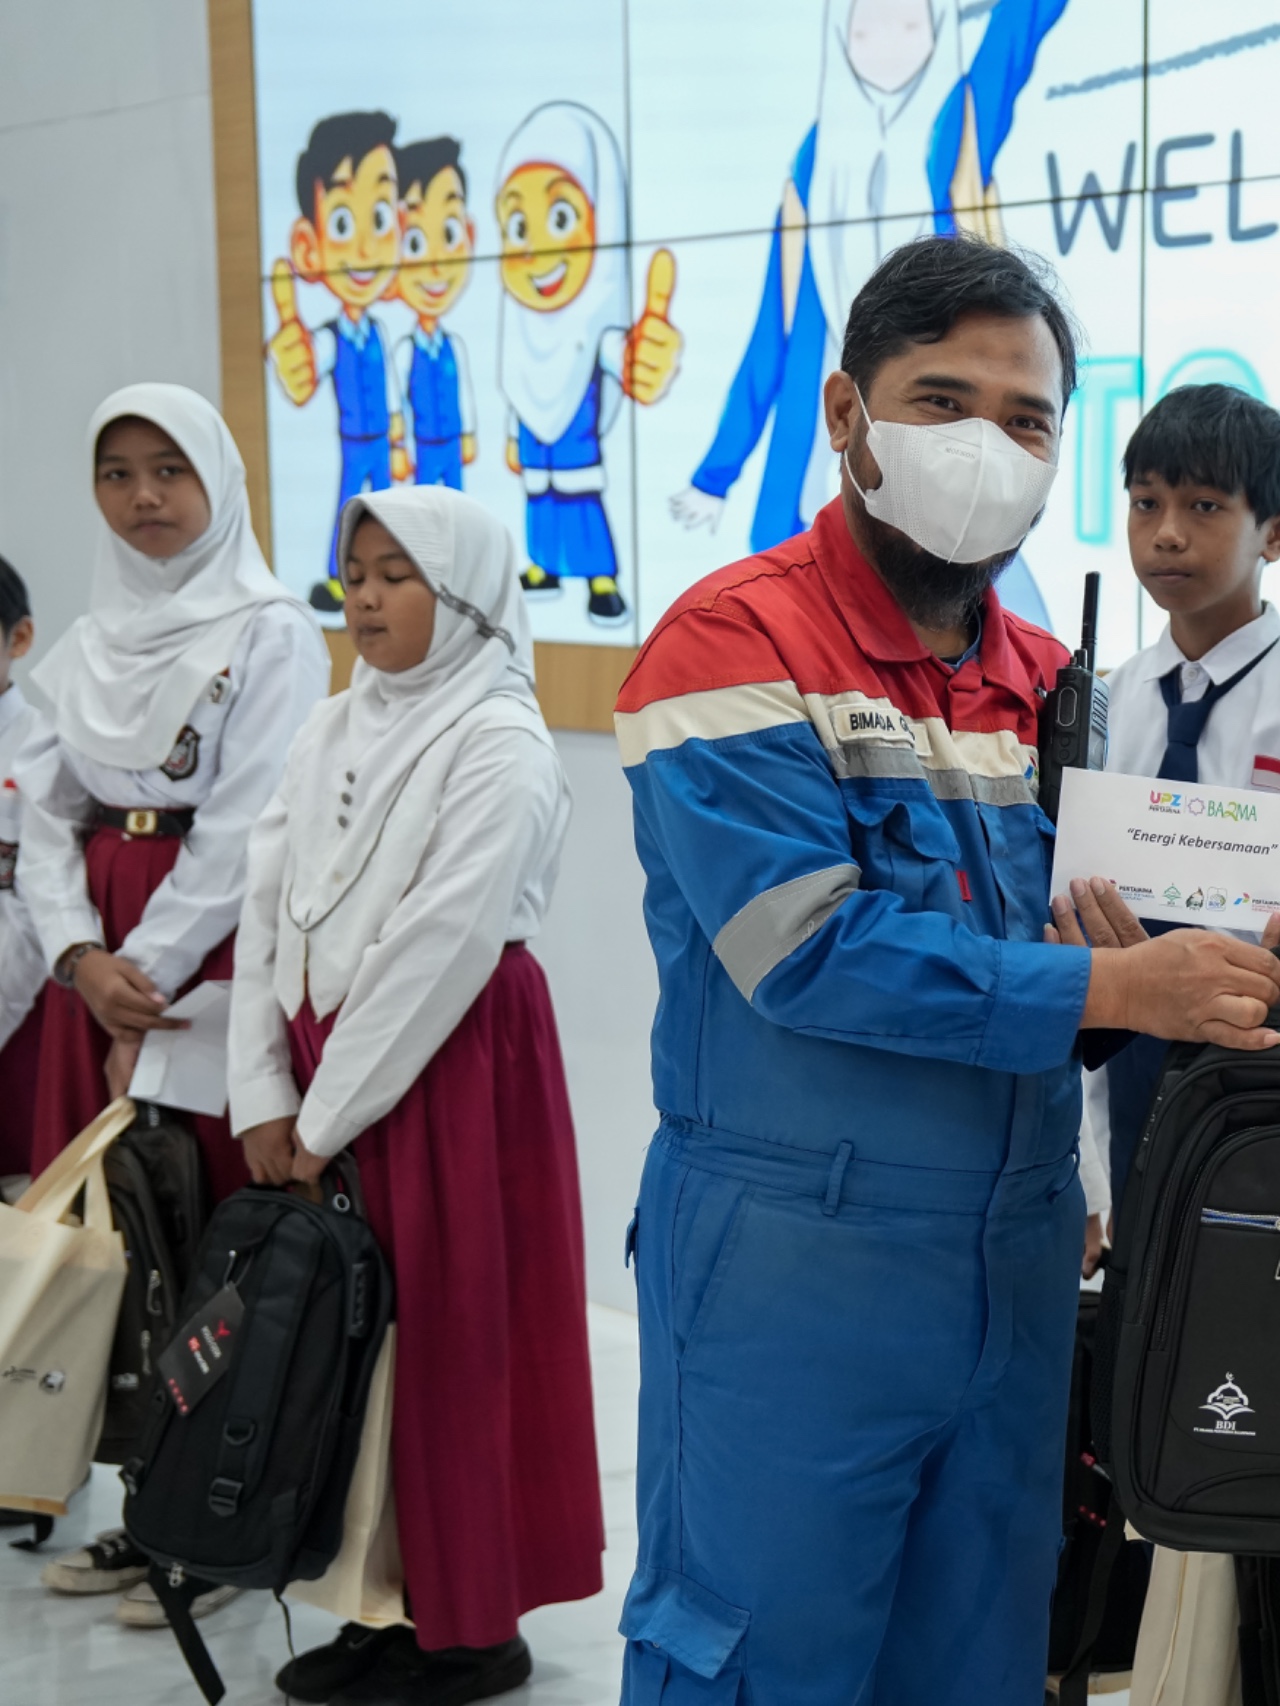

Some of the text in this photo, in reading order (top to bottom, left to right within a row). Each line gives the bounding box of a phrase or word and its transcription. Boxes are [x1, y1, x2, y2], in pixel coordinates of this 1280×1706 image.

[1073, 347, 1268, 547] T
[1149, 790, 1182, 807] UPZ
[1215, 1420, 1237, 1431] BDI
